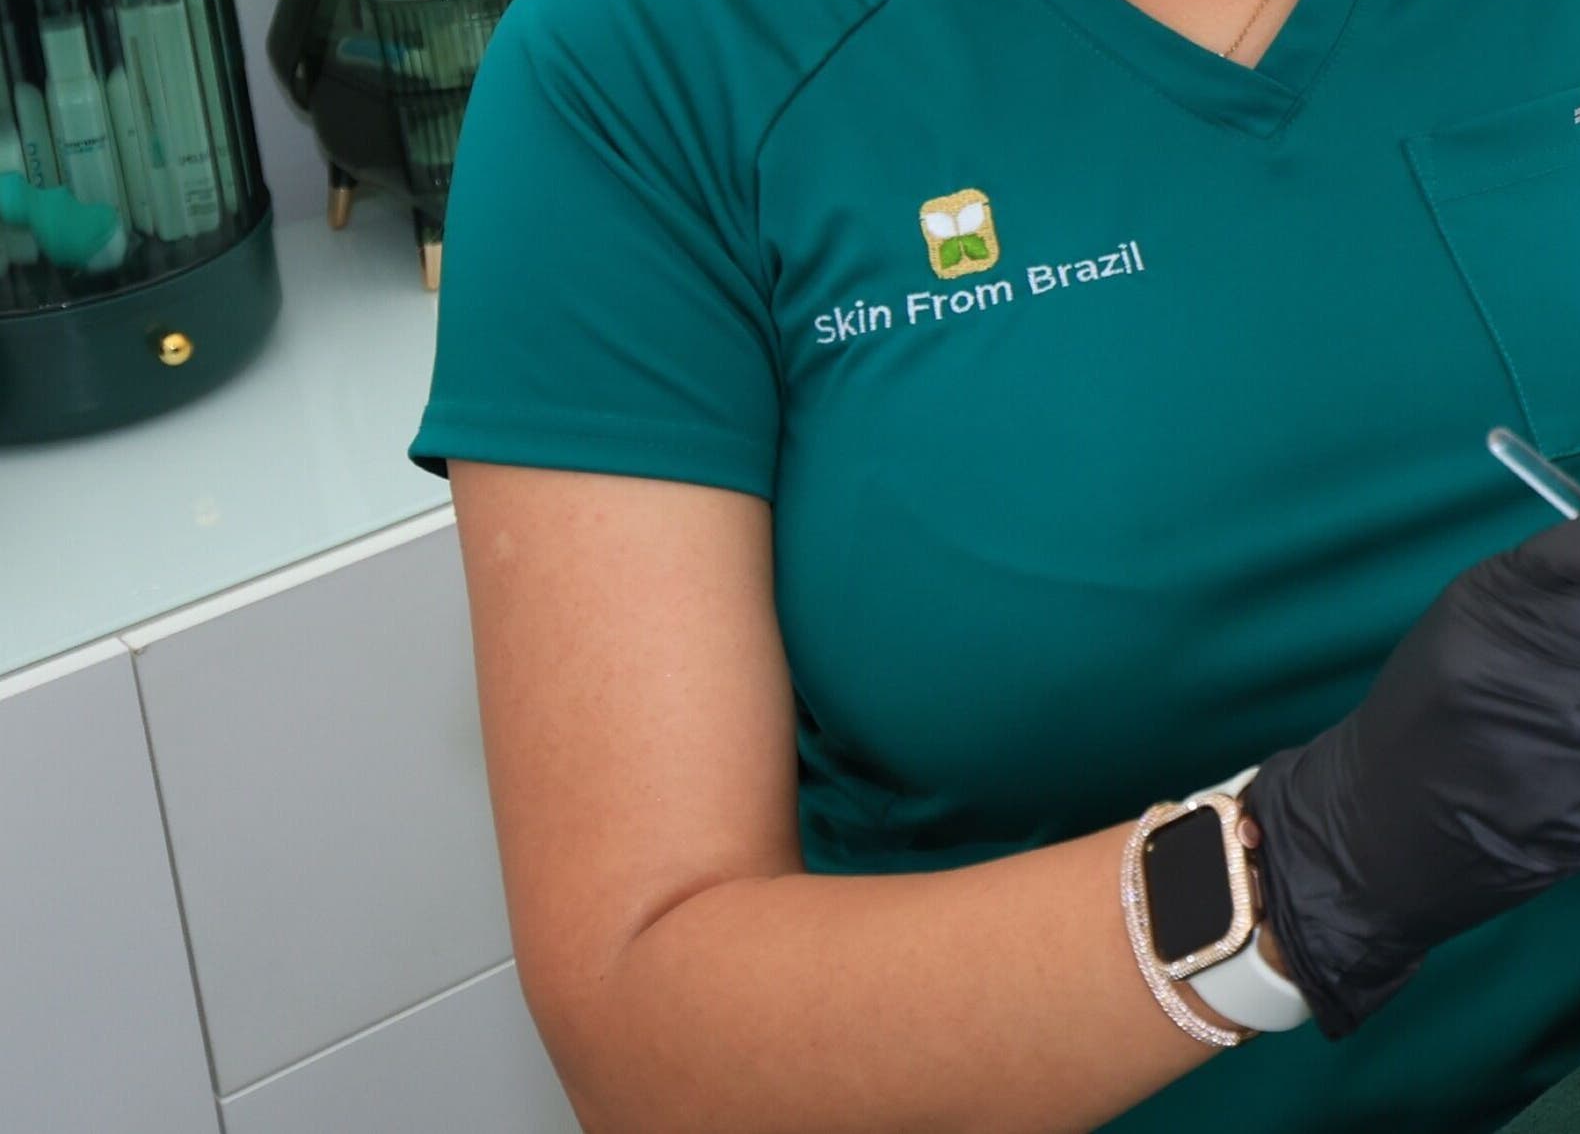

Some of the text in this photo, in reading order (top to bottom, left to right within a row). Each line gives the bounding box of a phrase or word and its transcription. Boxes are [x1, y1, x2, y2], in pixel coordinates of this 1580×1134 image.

[814, 240, 1146, 344] Skin From Brazil
